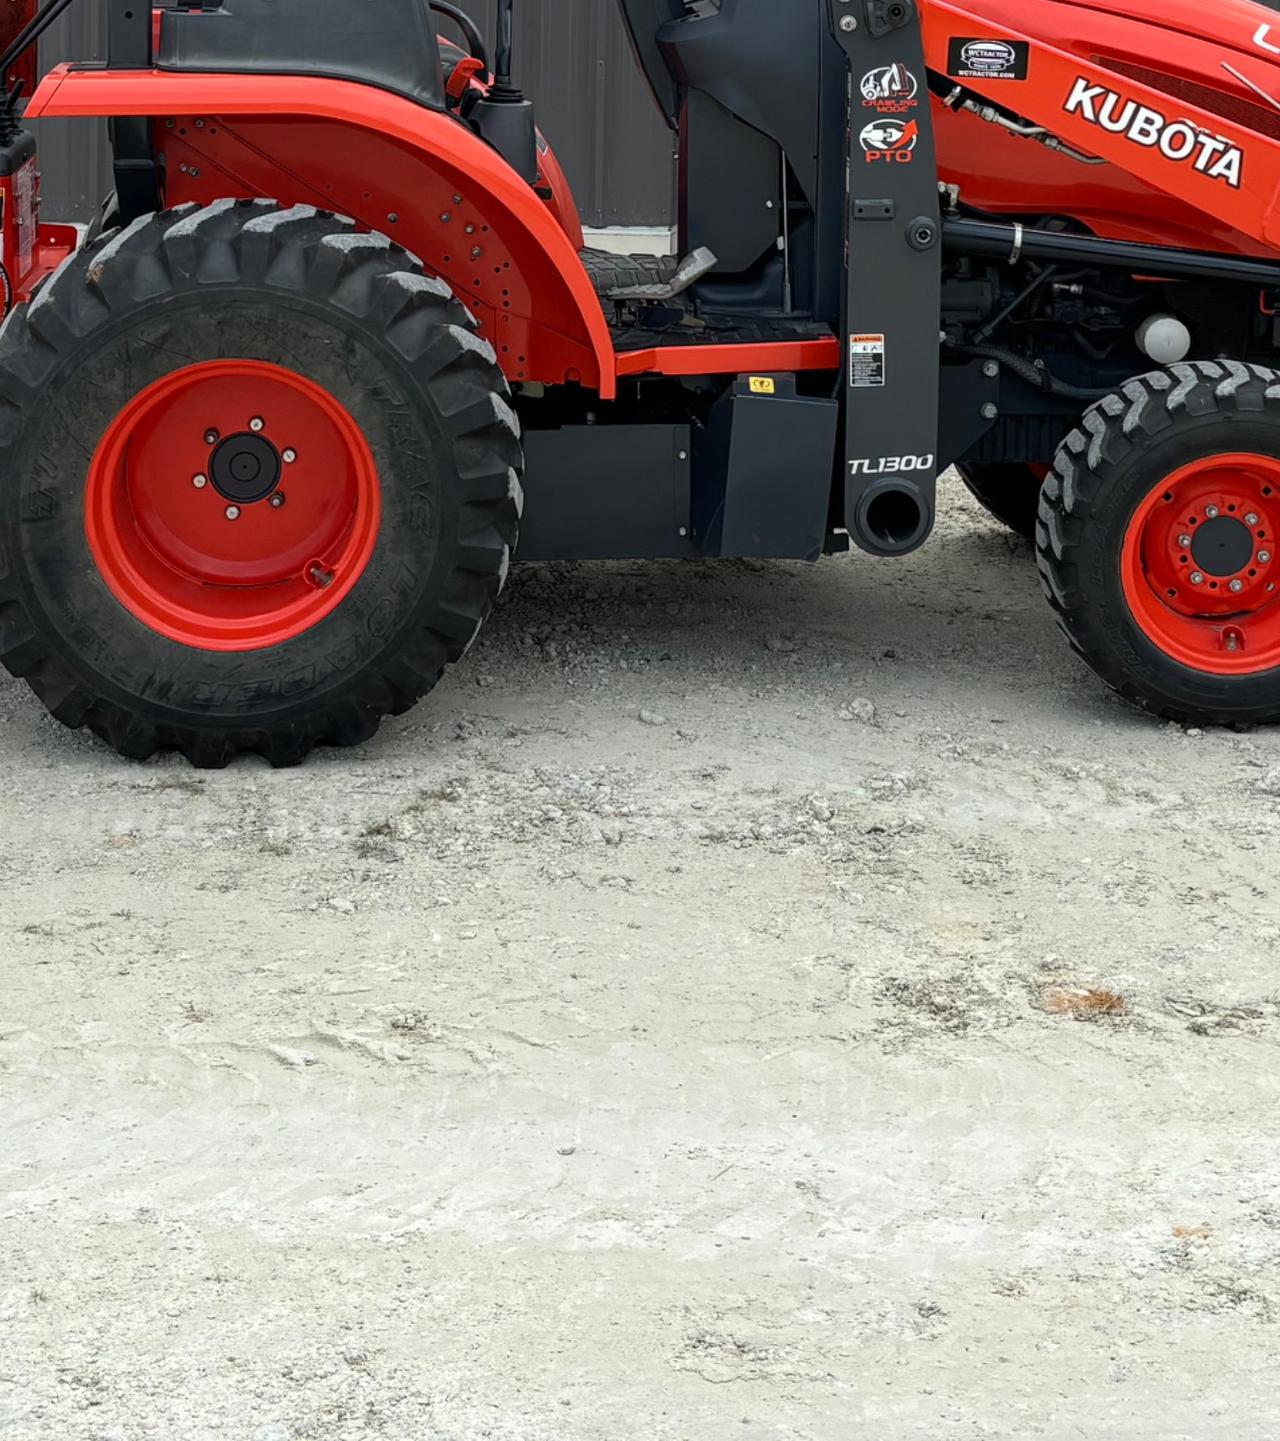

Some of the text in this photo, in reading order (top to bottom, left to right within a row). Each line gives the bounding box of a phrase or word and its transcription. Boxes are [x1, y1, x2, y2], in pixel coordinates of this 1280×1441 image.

[861, 99, 918, 107] CRAWLING
[1063, 76, 1244, 189] KUBOTA
[865, 150, 913, 163] PTO
[847, 453, 934, 475] TL1300
